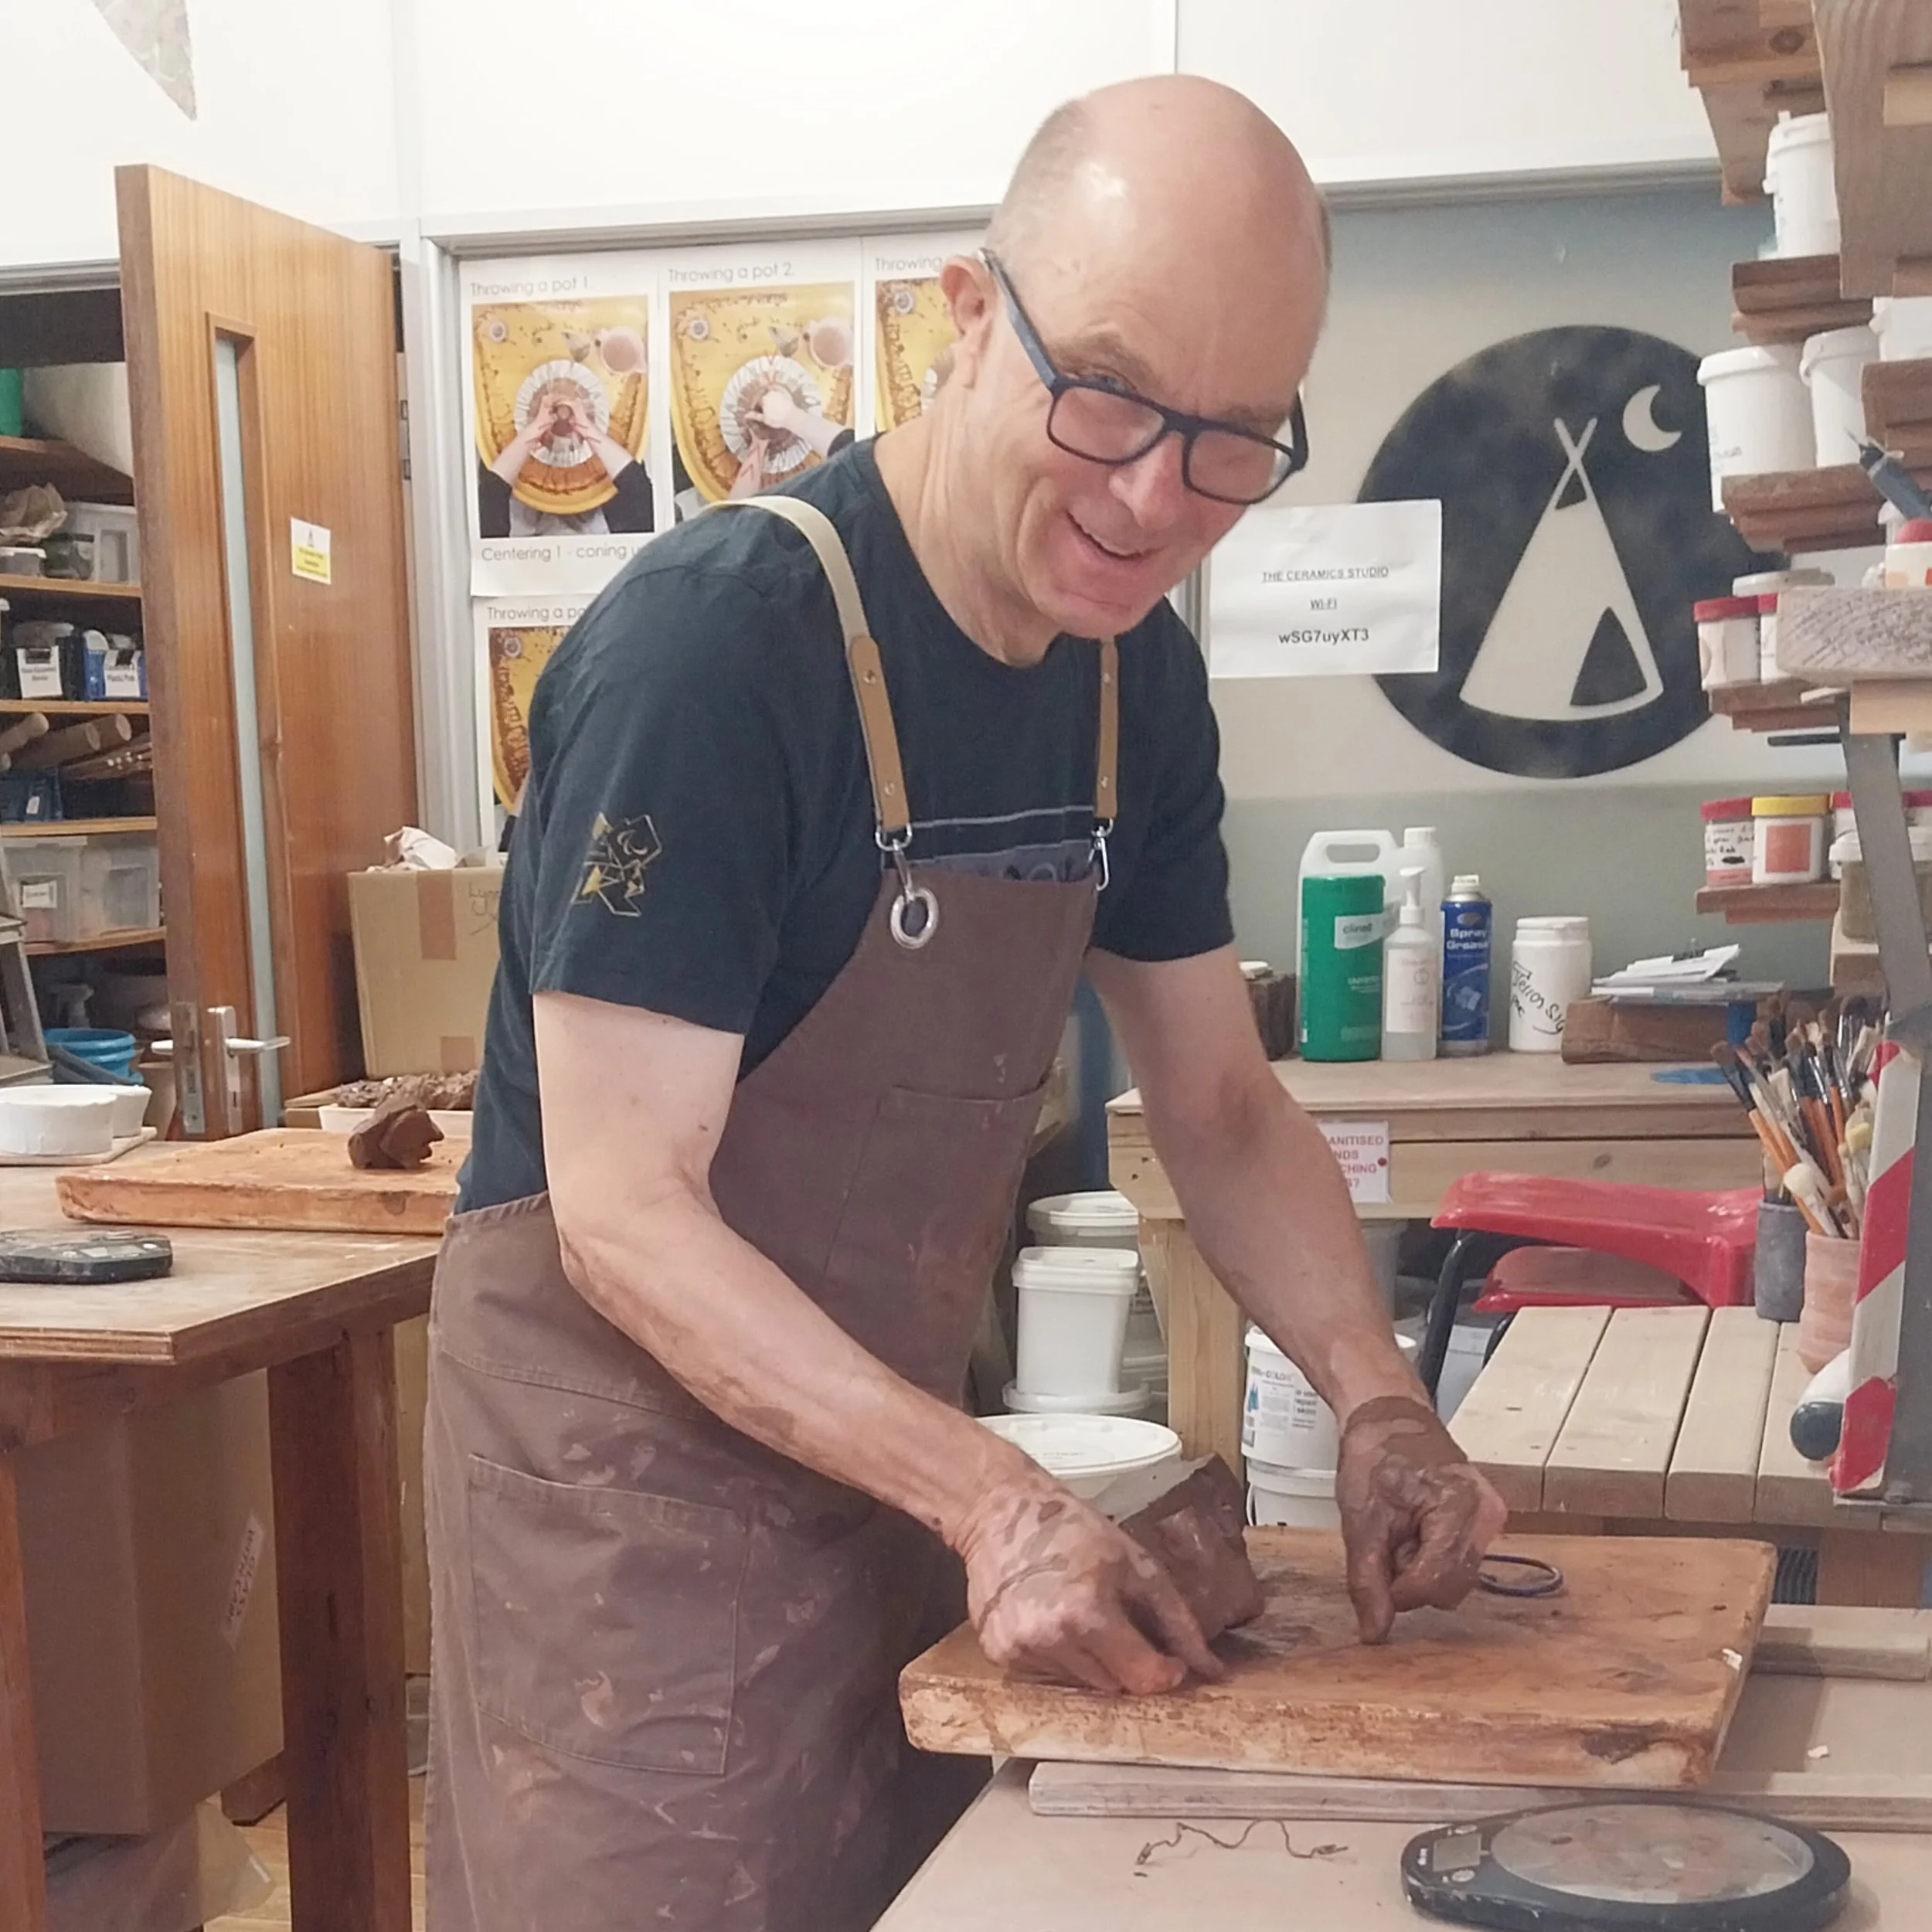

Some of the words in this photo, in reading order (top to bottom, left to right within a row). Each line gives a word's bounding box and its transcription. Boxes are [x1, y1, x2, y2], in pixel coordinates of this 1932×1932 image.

[874, 256, 943, 273] Throwing
[668, 266, 733, 283] Throwing
[738, 267, 748, 278] a
[752, 264, 778, 280] pot
[470, 282, 533, 296] Throwing
[538, 281, 548, 291] a
[552, 277, 577, 294] pot
[481, 546, 551, 562] Centering
[576, 543, 627, 560] coning
[1261, 571, 1282, 583] THE
[1286, 568, 1344, 581] CERAMICS
[1348, 565, 1389, 580] STUDIO
[487, 606, 549, 622] Throwing
[553, 608, 563, 618] a
[567, 607, 587, 621] po
[1278, 628, 1369, 645] wSG7uyXT3
[1450, 927, 1487, 939] Spray
[1329, 1135, 1383, 1145] ANITISED
[1334, 1149, 1359, 1160] NDS
